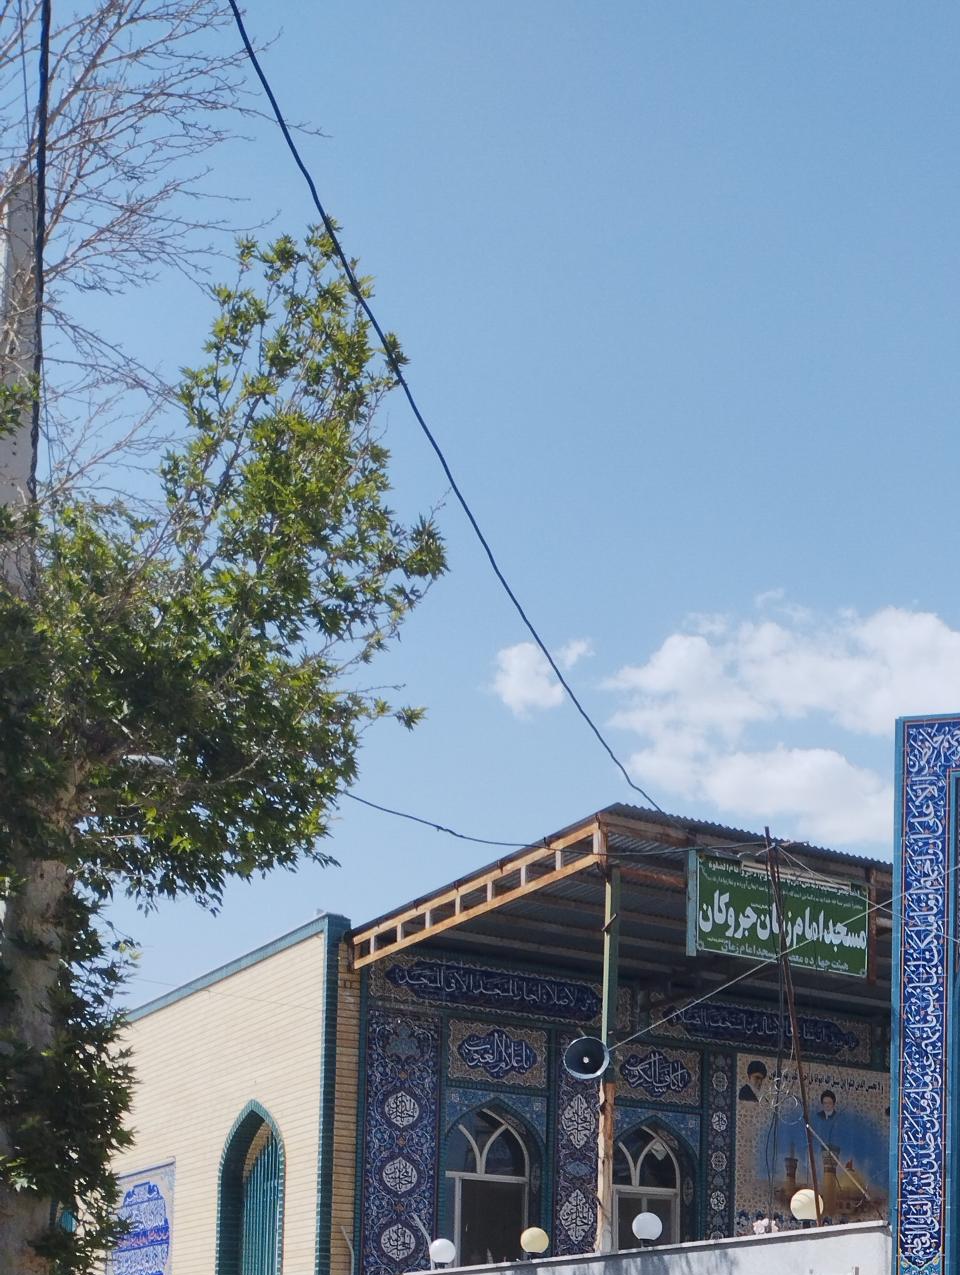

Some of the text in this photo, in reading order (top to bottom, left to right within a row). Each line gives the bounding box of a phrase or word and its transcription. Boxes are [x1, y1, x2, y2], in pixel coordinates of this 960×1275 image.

[757, 902, 793, 948] زان
[793, 906, 825, 950] امام
[824, 918, 867, 953] مسجد
